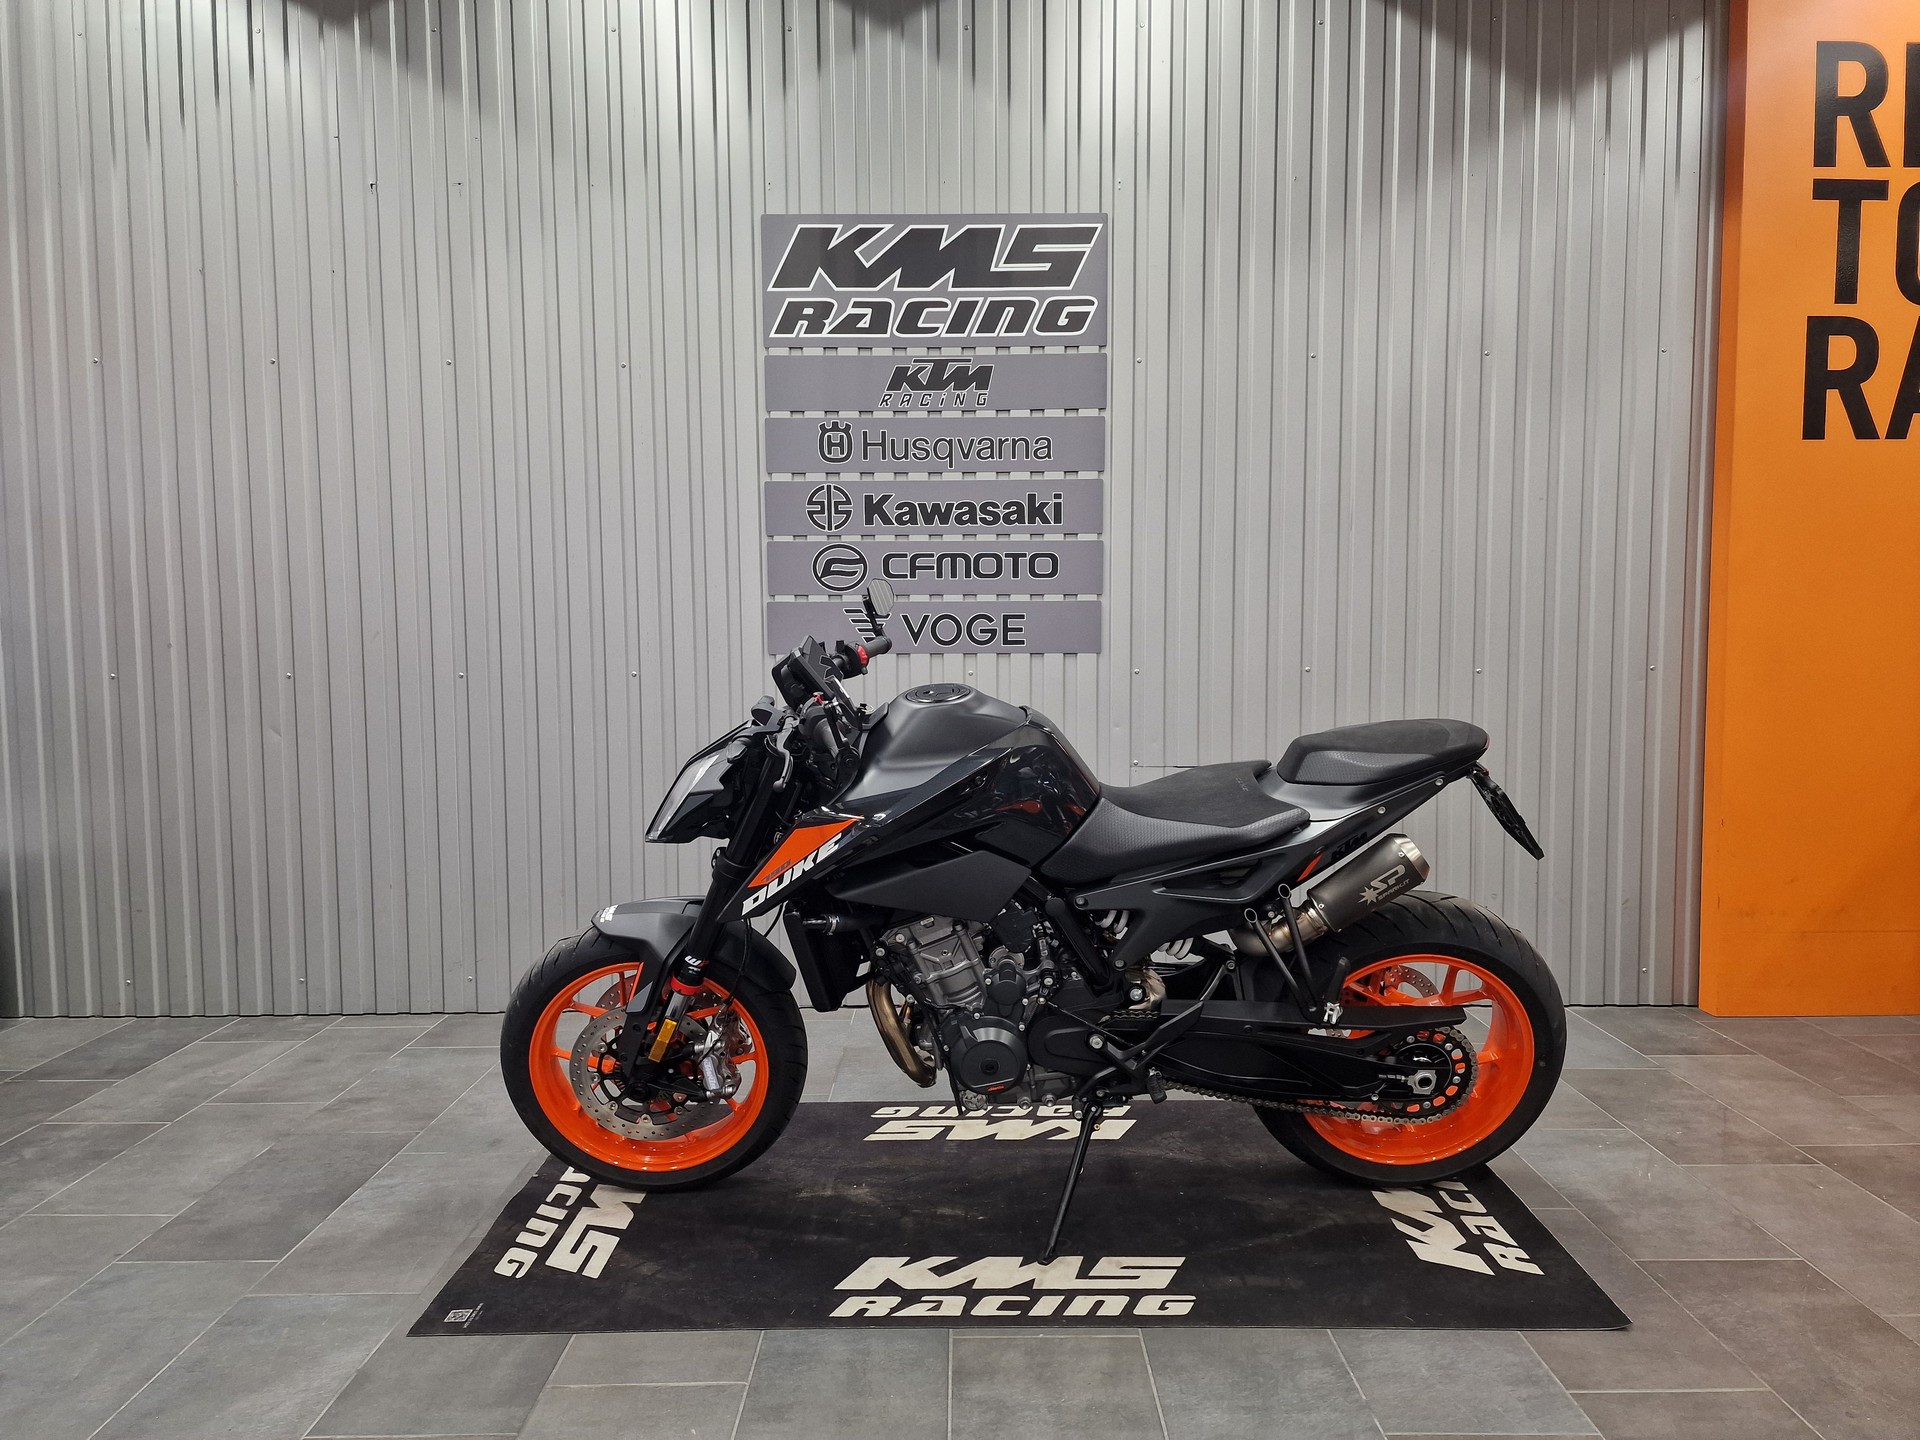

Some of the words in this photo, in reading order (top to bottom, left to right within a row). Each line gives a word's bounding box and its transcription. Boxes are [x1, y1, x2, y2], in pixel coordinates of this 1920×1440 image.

[767, 223, 1103, 291] KMS
[769, 296, 1098, 337] RACING
[885, 358, 994, 391] KTM
[862, 430, 1053, 469] Husqvarna
[863, 492, 1063, 526] Kawasaki
[882, 552, 1060, 579] CFMOTO
[900, 613, 1027, 647] VOGE
[741, 832, 842, 916] DUKE
[863, 1119, 1137, 1141] KMS
[545, 1184, 647, 1279] MS
[1372, 1186, 1495, 1275] KM
[1431, 1180, 1545, 1275] RACI
[834, 1256, 1186, 1290] KMS
[829, 1295, 1196, 1316] RACING
